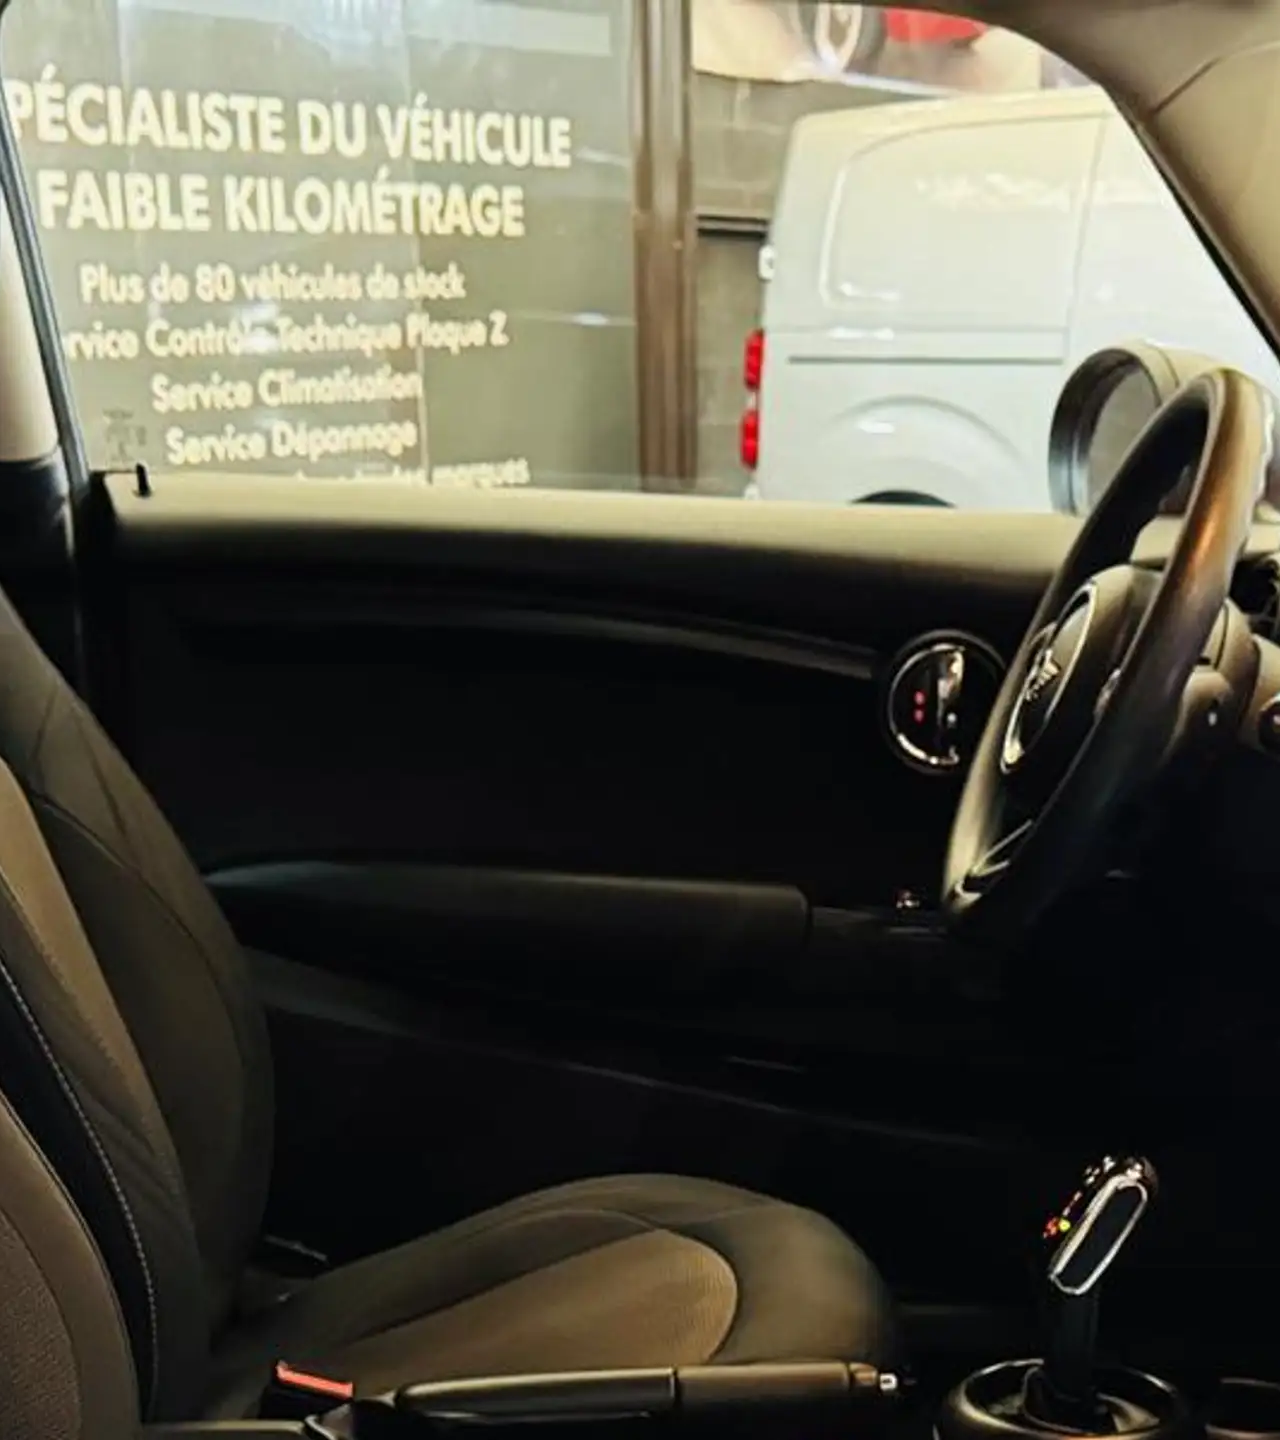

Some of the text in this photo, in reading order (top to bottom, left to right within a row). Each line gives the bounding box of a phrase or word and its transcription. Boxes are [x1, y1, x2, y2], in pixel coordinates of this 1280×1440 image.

[4, 65, 572, 168] PÉCIALISTE DU VÉHICULE
[36, 166, 525, 238] FAIBLE KILOMÉTRAGE
[80, 262, 466, 303] Plus de 80 véhicules de stock
[69, 320, 139, 359] rvice
[489, 310, 509, 346] 2
[151, 364, 423, 413] Service Climatisation
[165, 419, 417, 466] Service Dépannage
